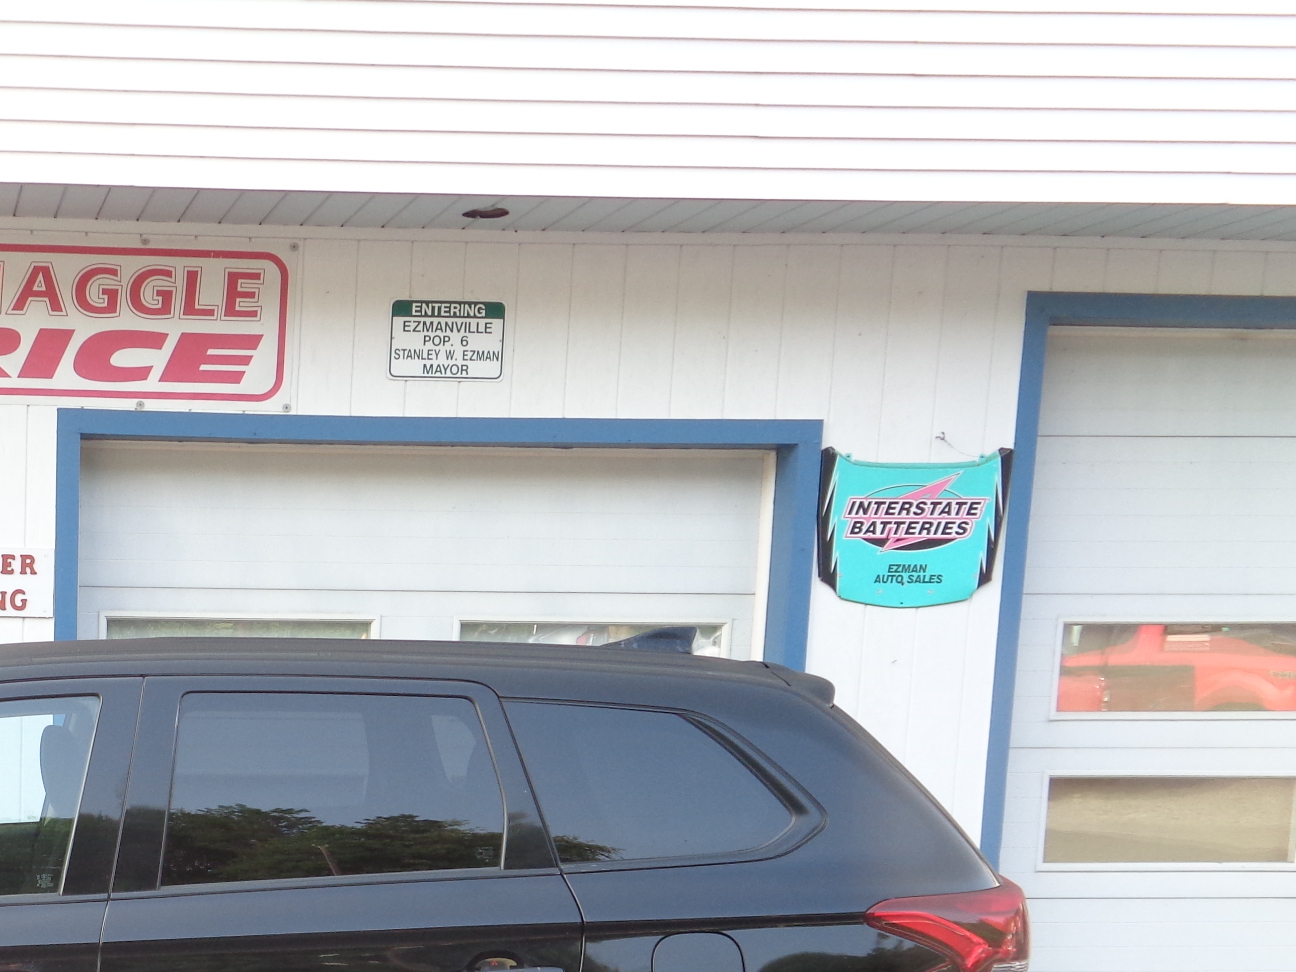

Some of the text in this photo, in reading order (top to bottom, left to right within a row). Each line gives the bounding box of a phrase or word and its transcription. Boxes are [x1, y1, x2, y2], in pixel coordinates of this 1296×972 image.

[411, 303, 485, 317] ENTERING
[402, 320, 493, 334] EZMANVILLE
[422, 335, 469, 347] POP. 6
[393, 348, 500, 362] STANLEY W. EZMAN
[422, 363, 469, 376] MAYOR
[847, 501, 981, 517] INTERSTATE
[849, 521, 969, 536] BATTERIES
[887, 564, 927, 574] EZMAN
[874, 574, 943, 585] AUTO SALES
